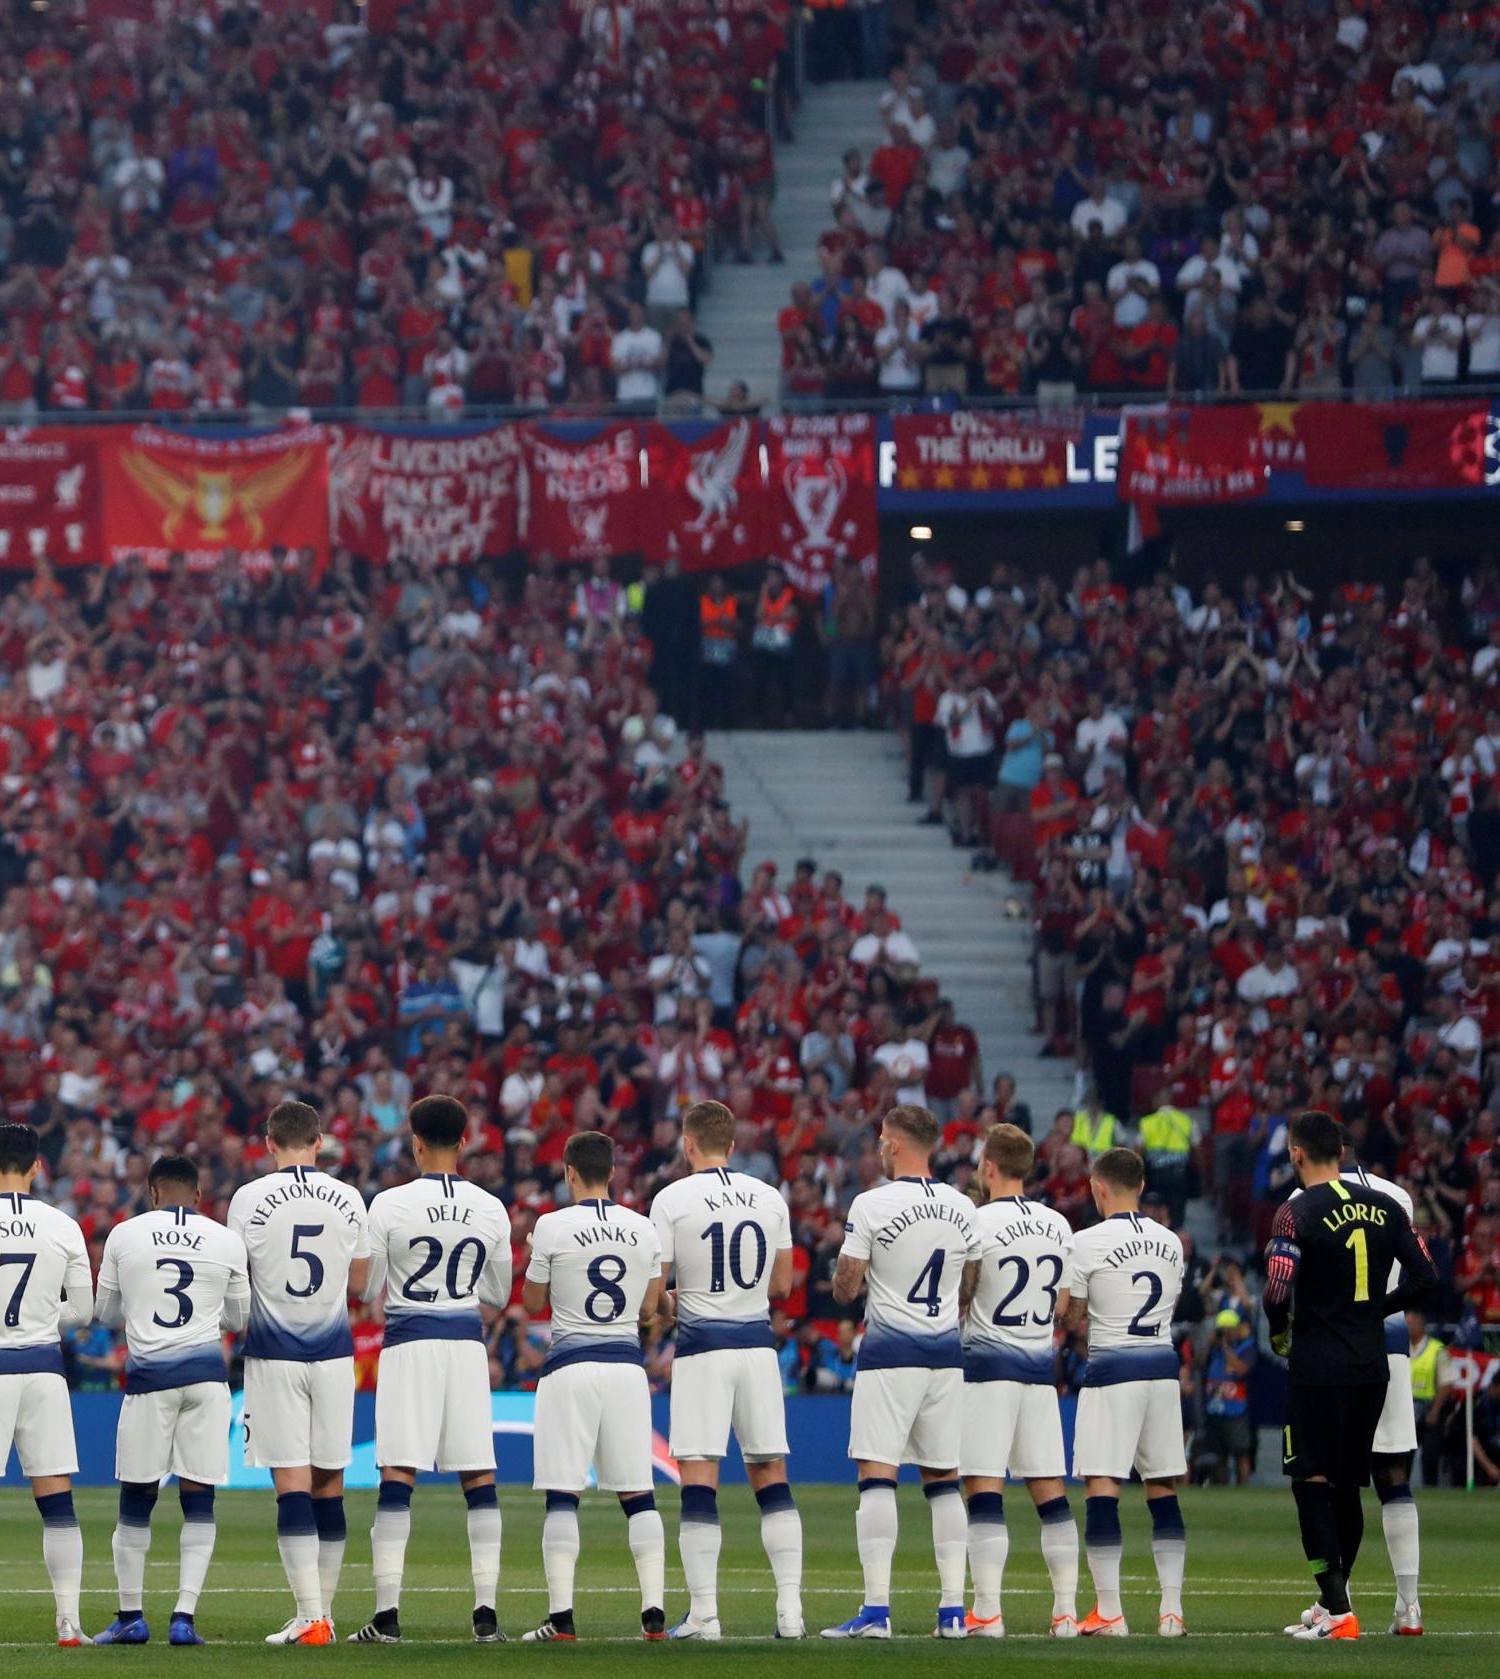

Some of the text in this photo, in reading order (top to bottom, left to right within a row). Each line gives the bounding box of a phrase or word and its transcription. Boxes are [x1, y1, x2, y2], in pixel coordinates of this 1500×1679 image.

[916, 436, 962, 464] THE
[968, 435, 1045, 464] WORLD
[250, 1182, 361, 1227] VERTONGHEN
[427, 1205, 474, 1226] DELE
[704, 1191, 758, 1212] KANE
[1323, 1203, 1387, 1233] LLORIS
[152, 1231, 206, 1251] ROSE
[573, 1227, 639, 1248] WINKS
[876, 1203, 975, 1251] ALDERWEIREL
[995, 1220, 1064, 1248] ERIKSEN
[285, 1224, 324, 1298] 5
[402, 1236, 486, 1303] 20
[700, 1220, 767, 1293] 10
[1103, 1240, 1179, 1269] TRIPPIER
[1345, 1227, 1370, 1302] 1
[152, 1258, 194, 1328] 3
[584, 1254, 627, 1323] 8
[907, 1248, 946, 1317] 4
[992, 1254, 1063, 1327] 23
[1128, 1271, 1163, 1337] 2
[1283, 1424, 1293, 1456] 1
